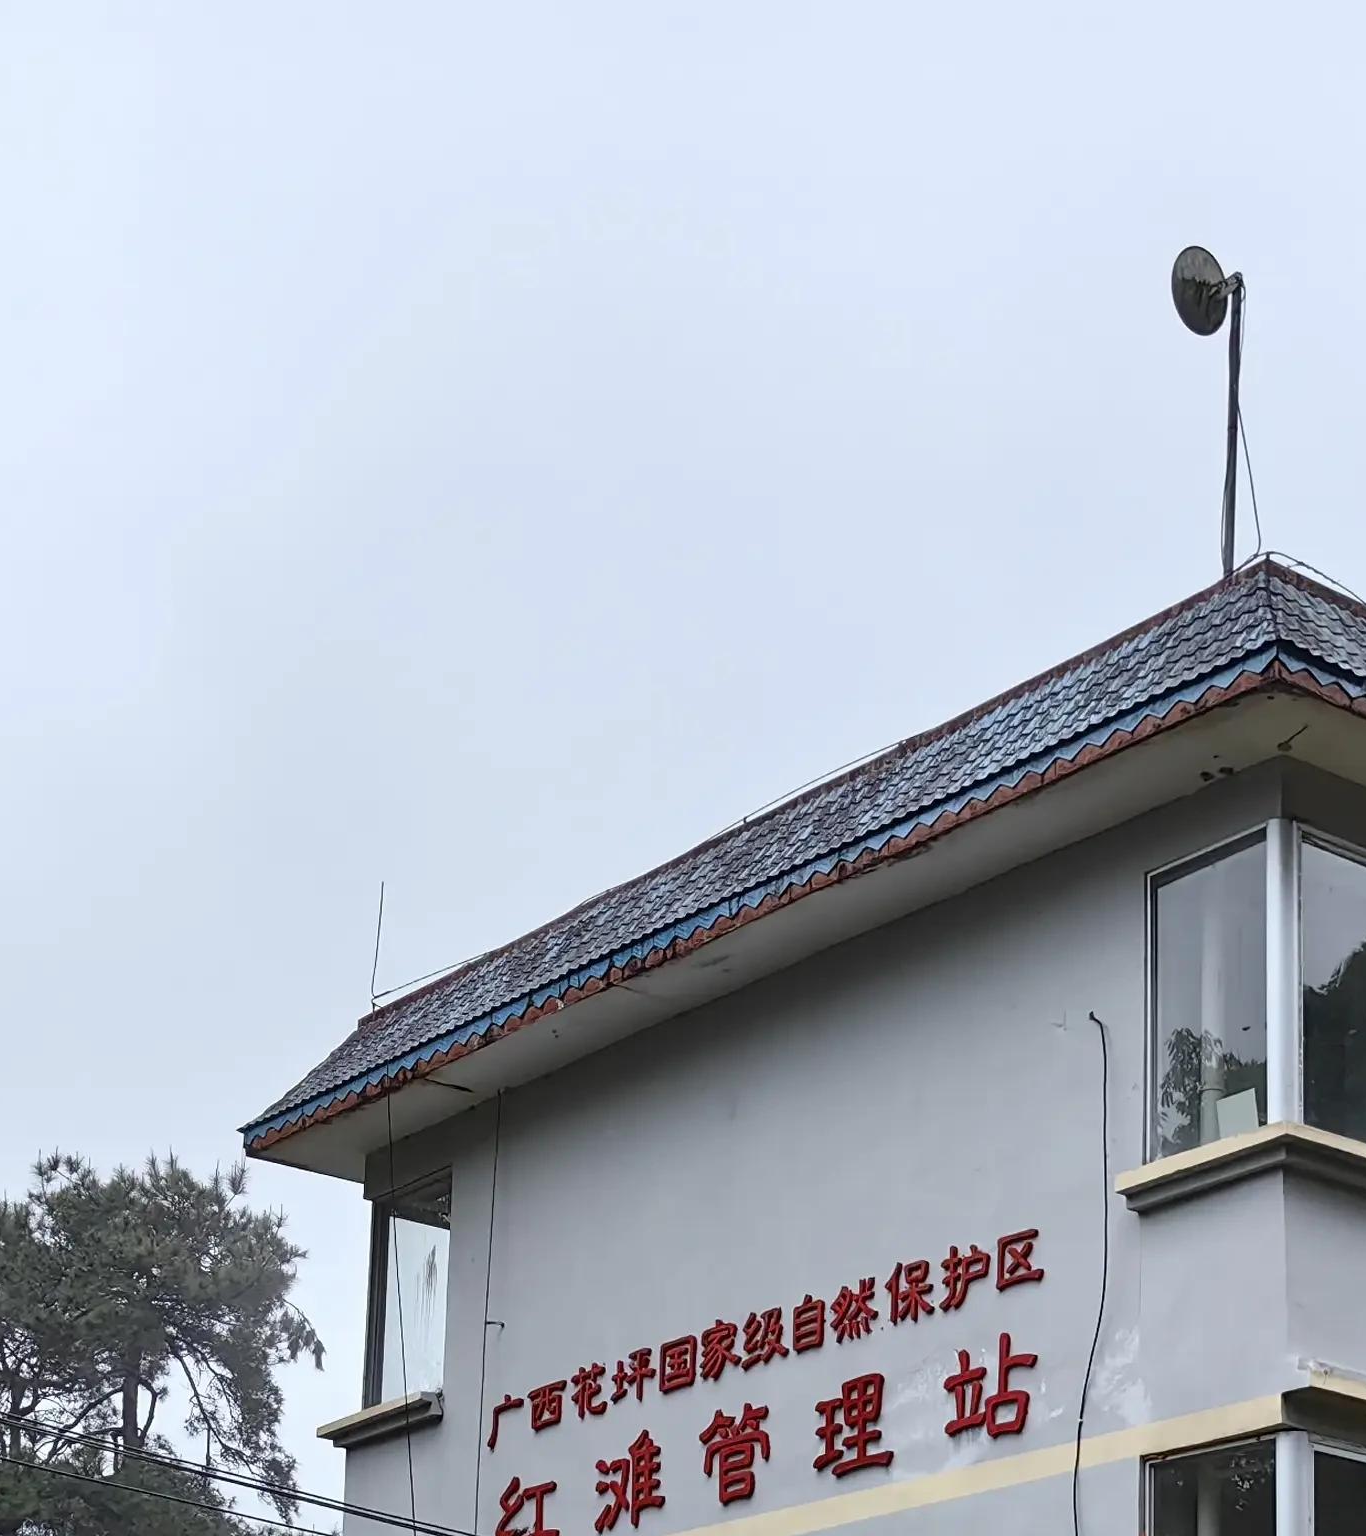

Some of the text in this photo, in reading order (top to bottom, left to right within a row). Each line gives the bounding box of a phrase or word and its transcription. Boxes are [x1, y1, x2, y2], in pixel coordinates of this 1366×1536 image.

[487, 1228, 1044, 1451] 广西花坪国家级自然保护区
